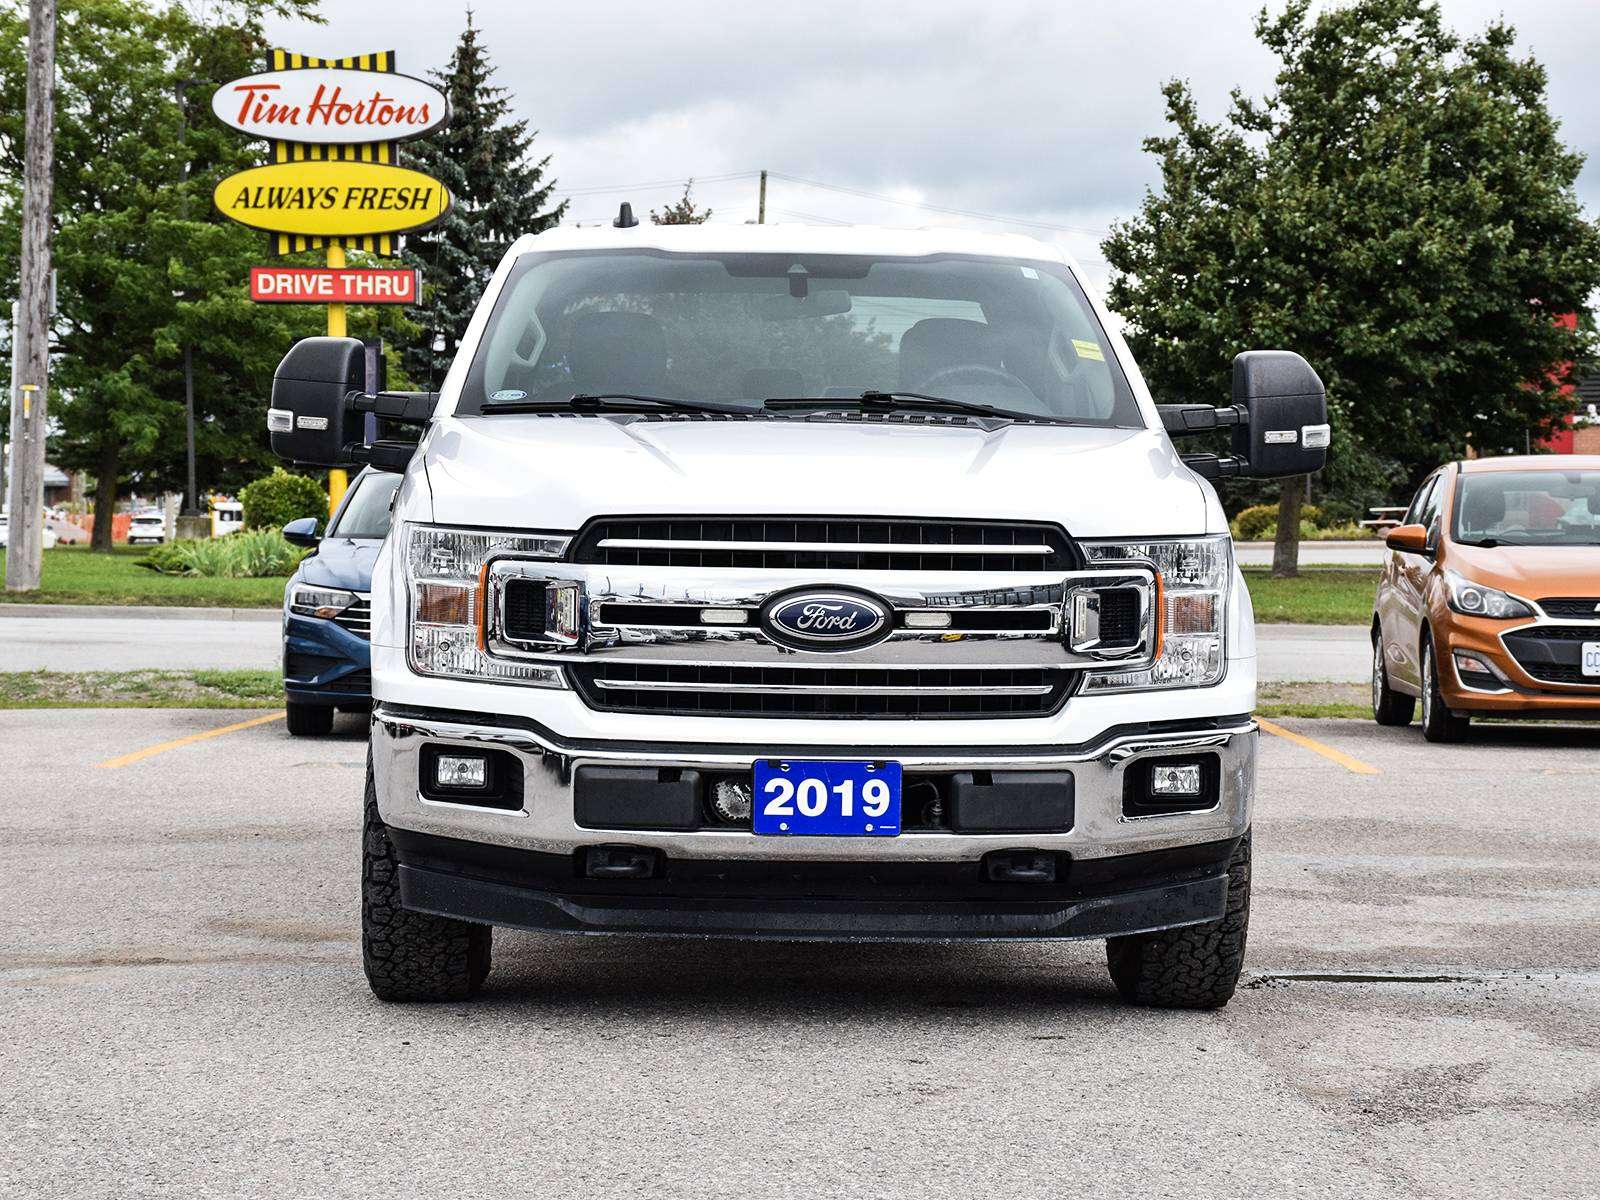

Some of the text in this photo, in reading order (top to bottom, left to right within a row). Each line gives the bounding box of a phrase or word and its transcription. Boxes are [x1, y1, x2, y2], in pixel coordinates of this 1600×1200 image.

[234, 84, 429, 125] Tim Hortons
[232, 187, 433, 210] ALWAYS FRESH
[257, 274, 410, 296] DRIVE THRU
[796, 603, 857, 630] Ford
[763, 777, 890, 817] 2019
